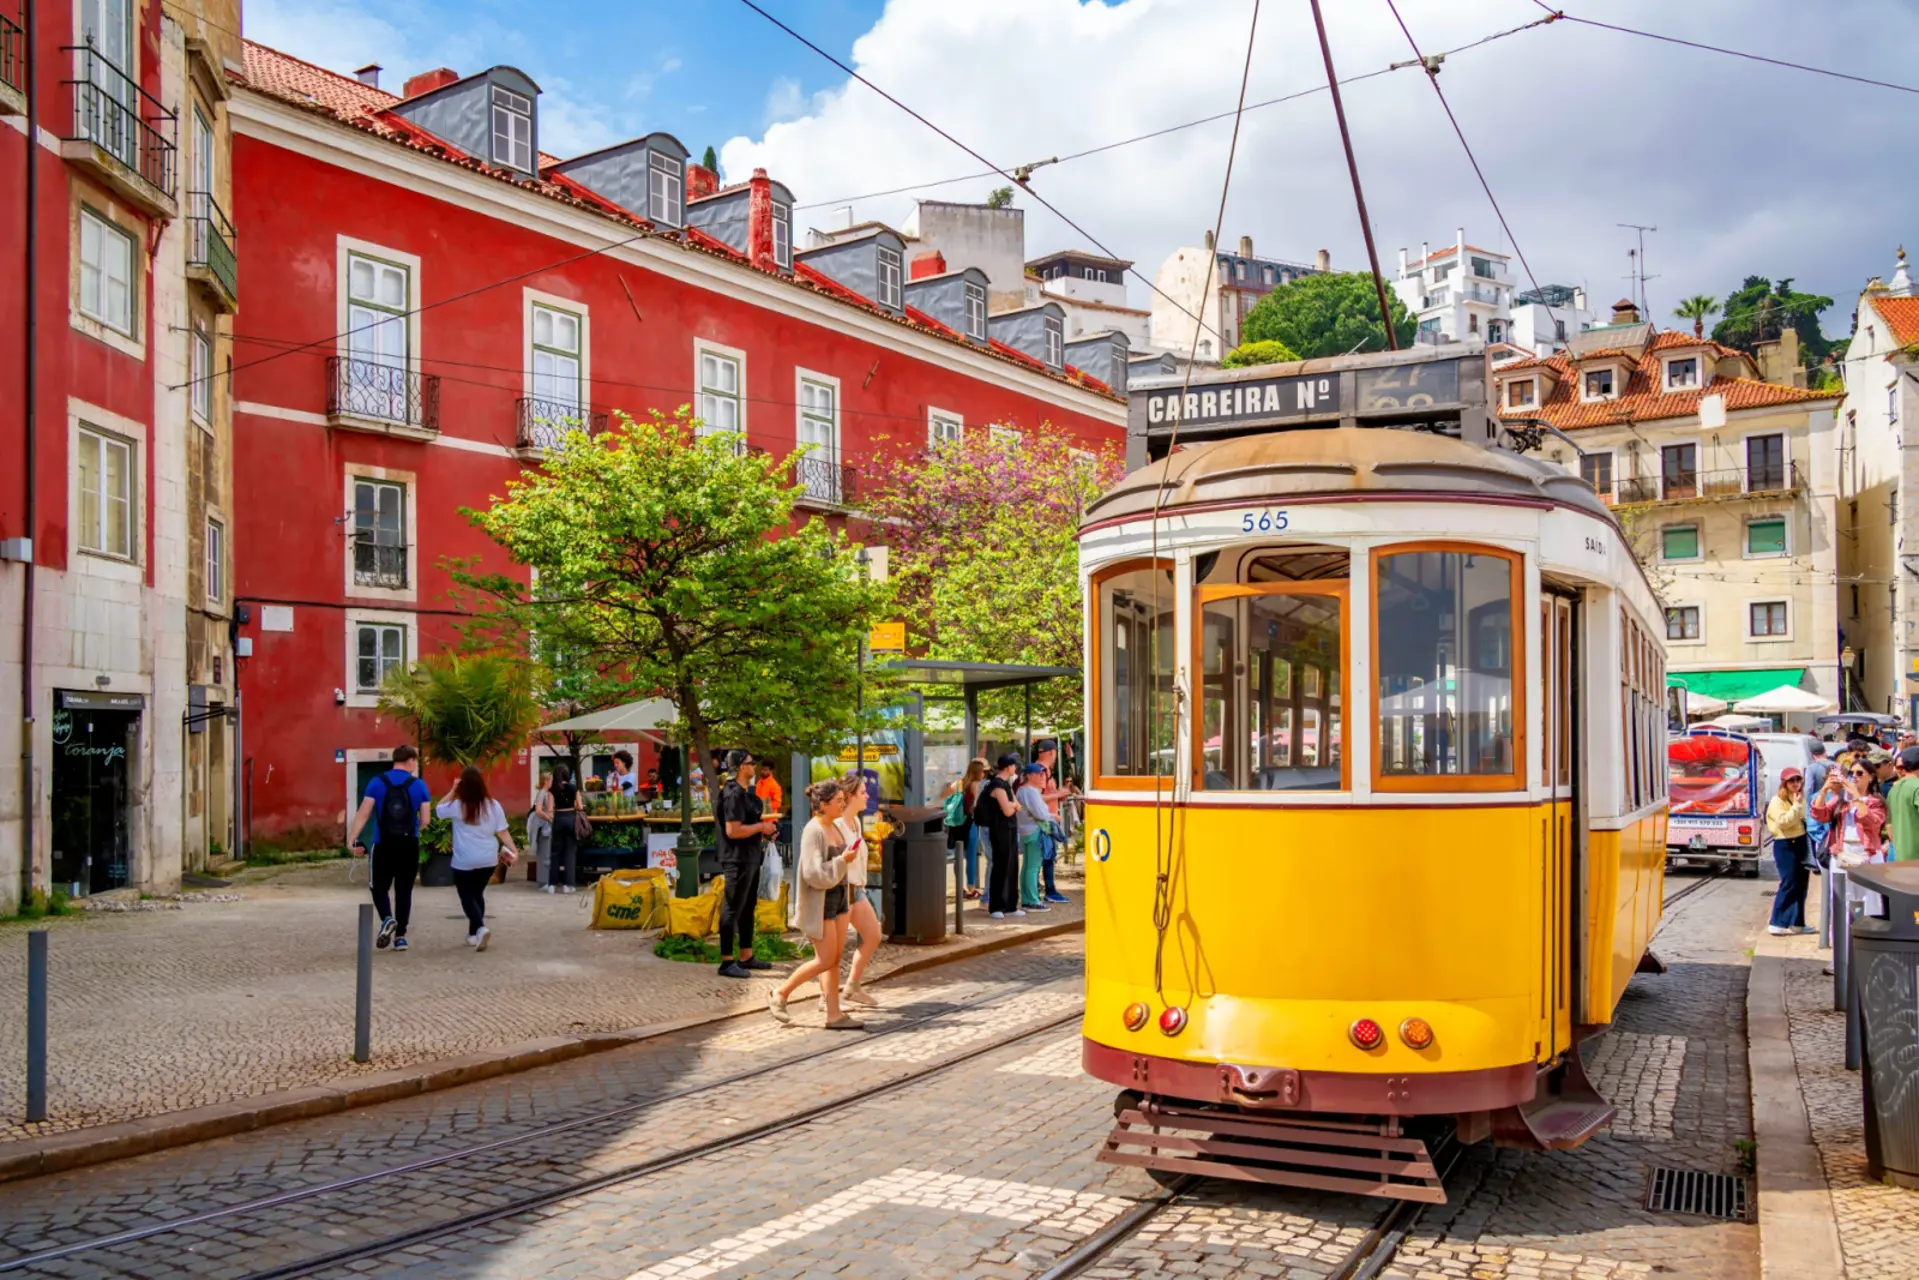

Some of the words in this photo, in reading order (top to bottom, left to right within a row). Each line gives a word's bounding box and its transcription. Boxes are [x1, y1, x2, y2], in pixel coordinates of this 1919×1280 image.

[1148, 385, 1280, 423] CARREIRA
[1242, 511, 1288, 532] 565
[607, 904, 640, 920] cme
